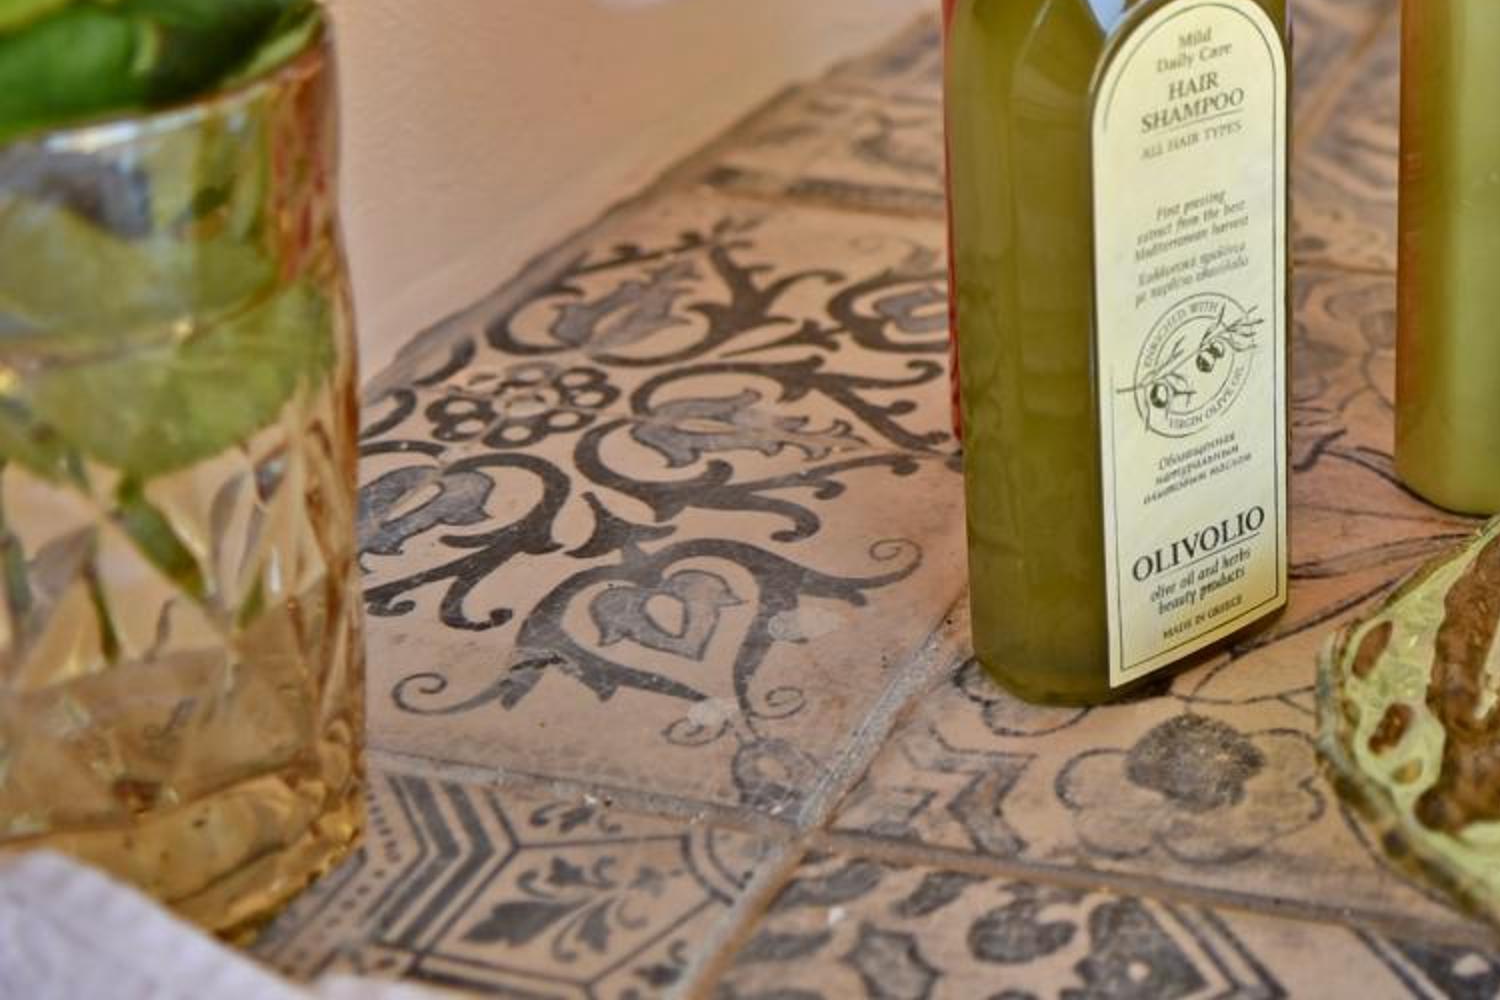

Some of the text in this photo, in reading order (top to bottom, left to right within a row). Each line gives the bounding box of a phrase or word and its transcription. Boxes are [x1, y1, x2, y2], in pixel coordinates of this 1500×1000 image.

[1156, 44, 1232, 73] Daily Care
[1179, 27, 1212, 47] Mild
[1168, 71, 1218, 100] HAIR
[1141, 87, 1245, 133] SHAMPOO
[1141, 120, 1243, 159] ALL HAIR TYPES
[1144, 301, 1219, 367] ENRICHED WITH
[1169, 415, 1202, 429] VIRGIN
[1205, 388, 1232, 419] OLIVE
[1132, 505, 1265, 582] OLIVOLIO
[1151, 547, 1250, 602] olive oil and herbs
[1158, 566, 1246, 615] beauty products
[1163, 593, 1243, 639] MADE IN GREECE
